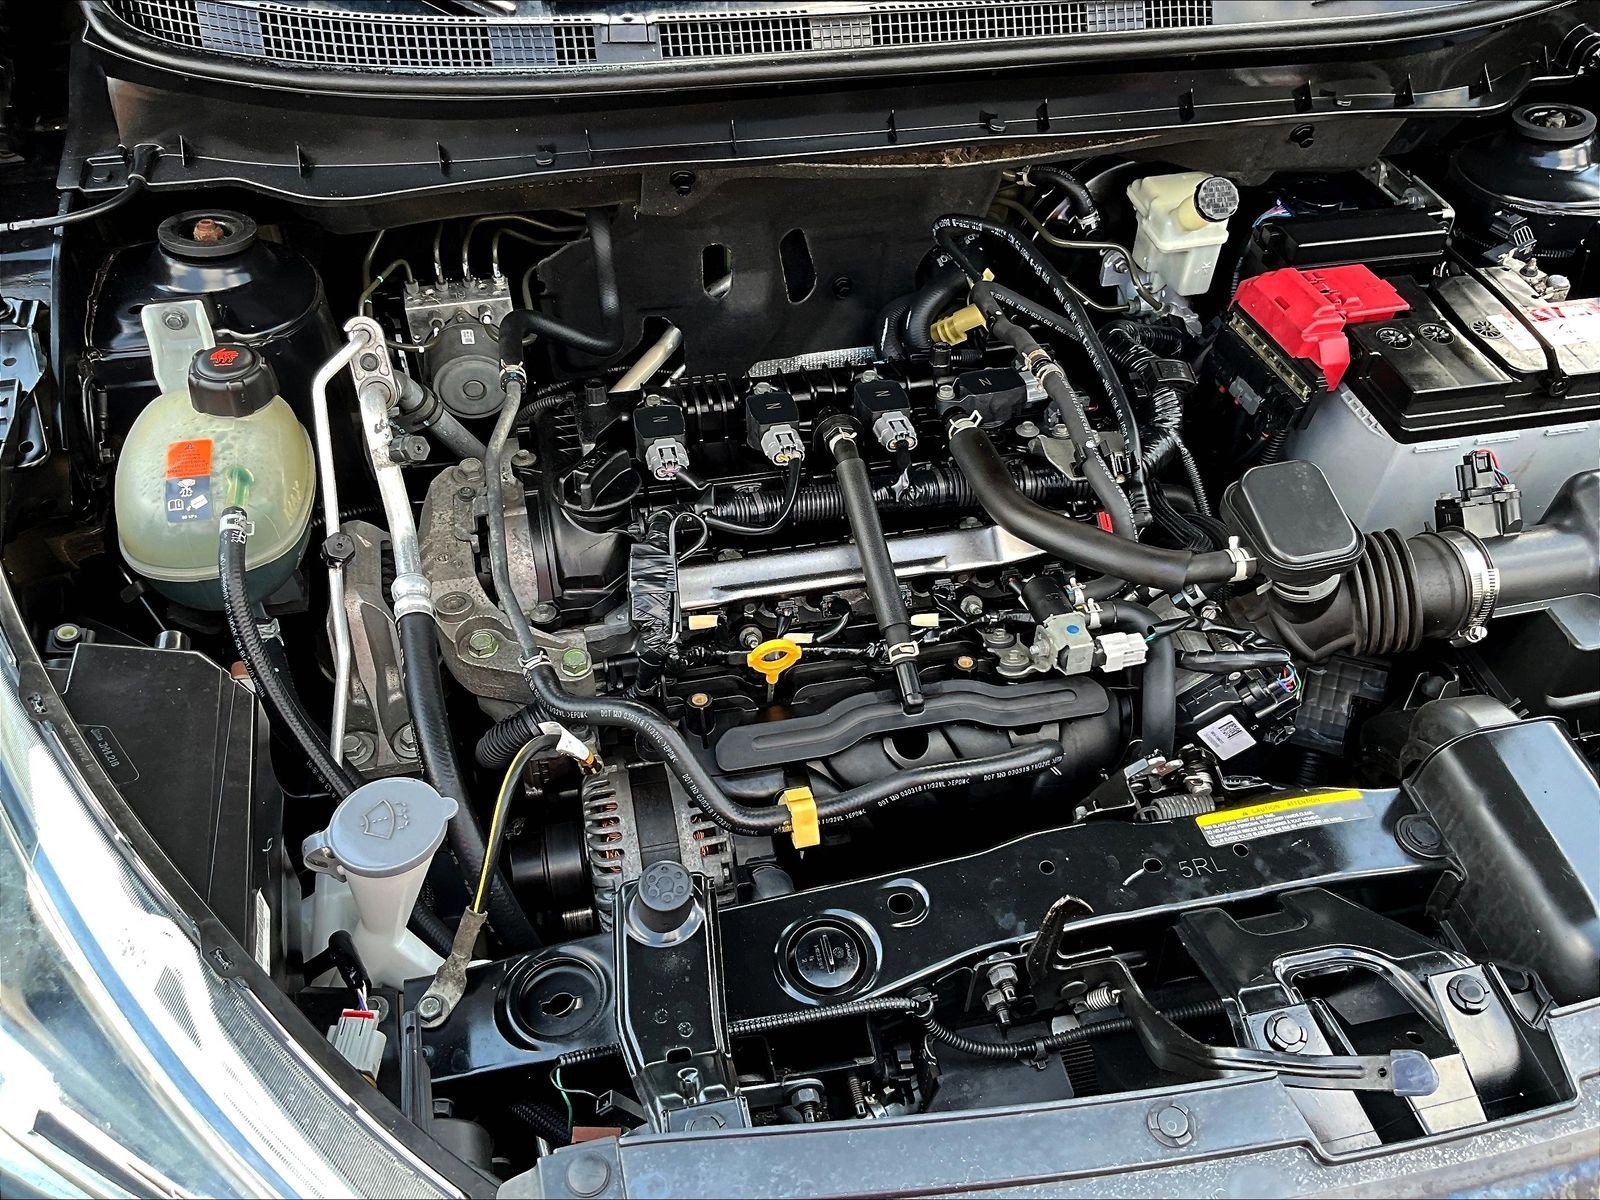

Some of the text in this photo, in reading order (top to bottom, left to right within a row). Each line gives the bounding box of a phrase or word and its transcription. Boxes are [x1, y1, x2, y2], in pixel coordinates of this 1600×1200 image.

[1251, 796, 1321, 815] CAUTION ATTENTION
[1178, 856, 1228, 878] 5RL
